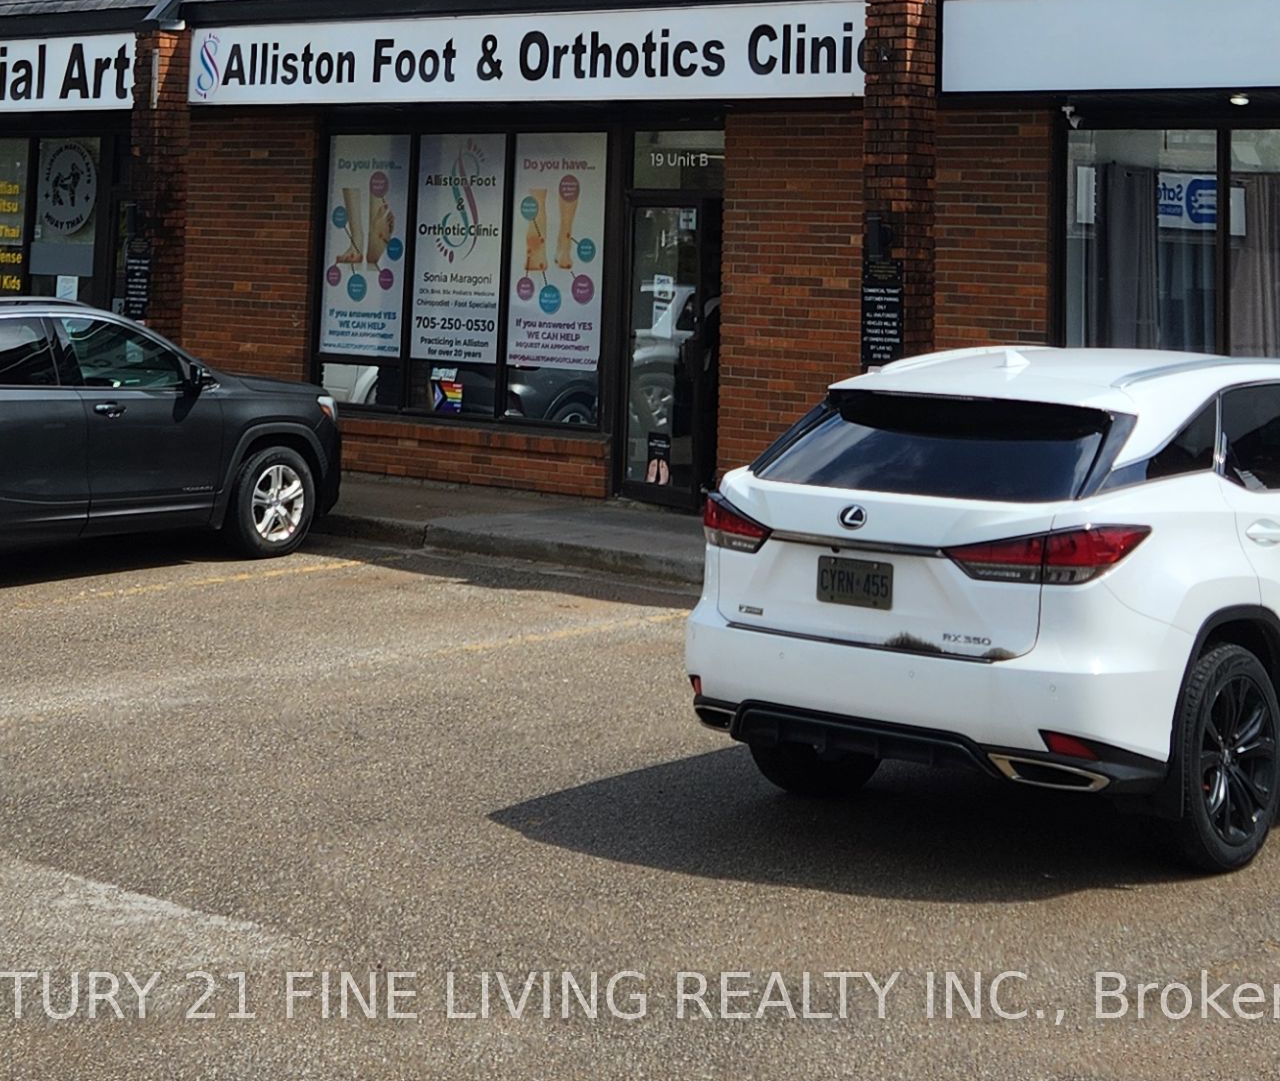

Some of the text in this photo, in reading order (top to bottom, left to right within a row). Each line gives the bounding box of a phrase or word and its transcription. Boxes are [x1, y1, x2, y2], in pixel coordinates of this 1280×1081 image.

[222, 41, 355, 86] Alliston
[372, 37, 456, 83] Foot
[476, 34, 503, 81] &
[519, 28, 726, 81] Orthotics
[59, 41, 134, 100] Art
[338, 159, 351, 169] Do
[352, 161, 370, 171] you
[523, 159, 538, 169] Do
[540, 161, 560, 172] you
[650, 152, 709, 167] 19 Unit B
[425, 175, 496, 186] Alliston Foot
[456, 198, 465, 211] &
[0, 224, 20, 238] Thai
[419, 224, 499, 237] Orthotic Clinic
[3, 275, 21, 291] Kids
[423, 272, 493, 286] Sonia Maragoni
[383, 311, 397, 320] YES
[339, 320, 350, 328] WE
[368, 321, 386, 330] HELP
[415, 316, 495, 332] 705-250-0530
[515, 318, 593, 331] If you answered YES
[420, 336, 489, 347] Practicing in Alliston
[526, 331, 581, 341] WE CAN HELP
[427, 347, 436, 355] for
[464, 351, 482, 359] years
[820, 568, 889, 599] CYRN 455
[943, 633, 992, 646] RX 350
